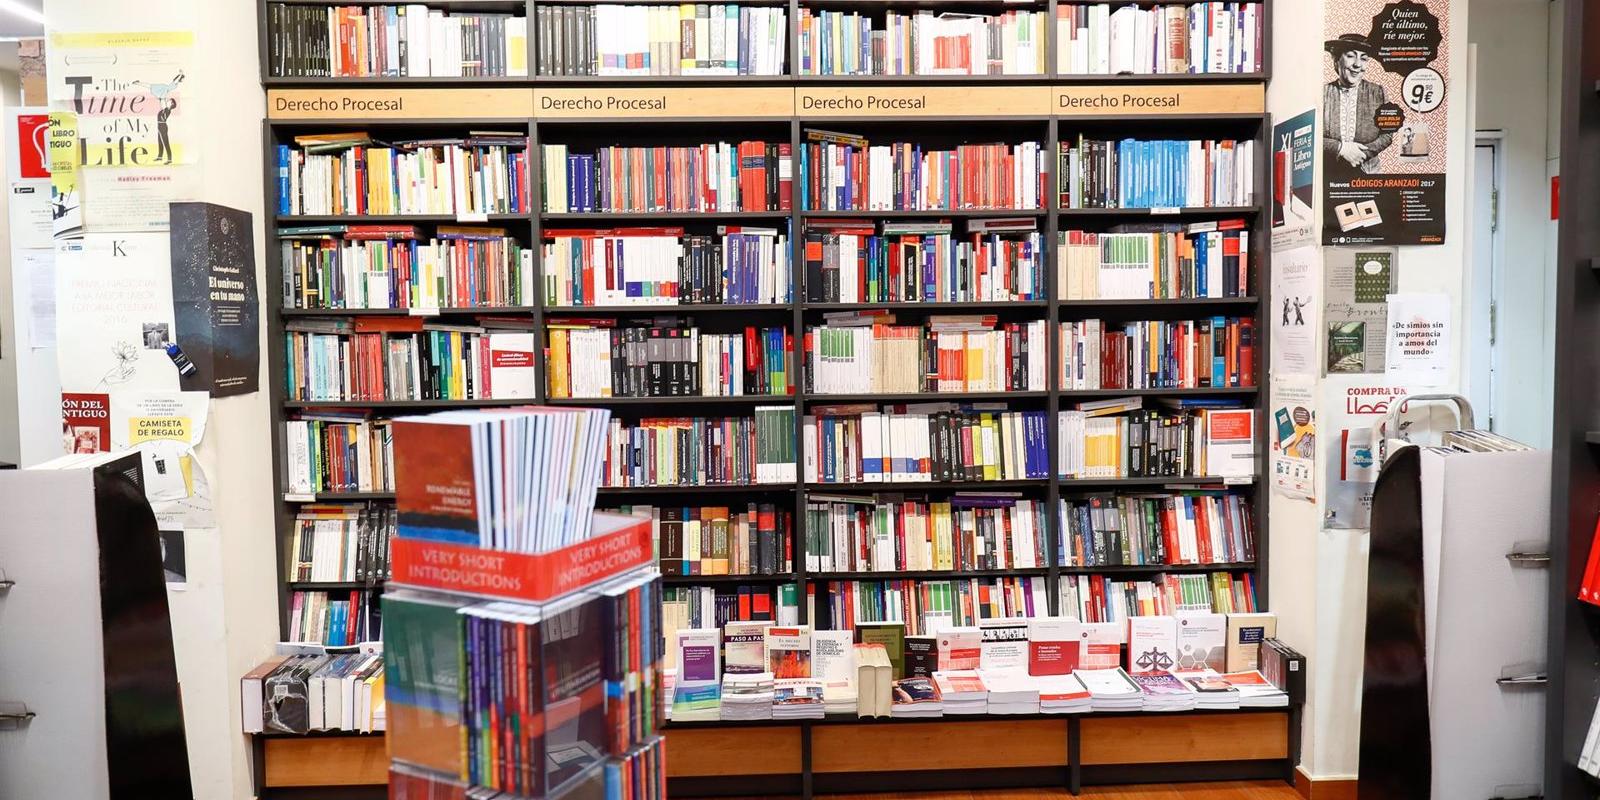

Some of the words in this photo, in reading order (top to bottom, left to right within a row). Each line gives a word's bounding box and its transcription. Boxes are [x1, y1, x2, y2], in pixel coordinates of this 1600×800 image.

[1392, 8, 1419, 18] Quien
[1382, 20, 1394, 29] ríe
[1396, 20, 1428, 30] último,
[1384, 31, 1396, 40] ríe
[1398, 31, 1426, 42] mejor.
[102, 78, 130, 90] The
[65, 76, 146, 114] Time
[1412, 84, 1424, 104] 9
[276, 98, 338, 111] Derecho
[342, 98, 402, 111] Procesal
[541, 97, 603, 110] Derecho
[607, 96, 666, 110] Procesal
[803, 96, 863, 109] Derecho
[868, 96, 926, 109] Procesal
[1060, 94, 1118, 108] Derecho
[1123, 94, 1180, 107] Procesal
[103, 118, 122, 133] of
[128, 118, 151, 138] My
[1281, 132, 1292, 151] XI
[80, 136, 148, 166] Life
[1294, 150, 1311, 162] Libro
[1351, 179, 1383, 188] CÓDIGOS
[1384, 179, 1419, 187] ARANZADI
[113, 240, 127, 256] K
[209, 276, 217, 288] El
[217, 278, 244, 289] universo
[210, 291, 219, 300] en
[220, 291, 227, 301] tu
[228, 292, 245, 302] mano
[1348, 388, 1390, 396] COMPRA
[80, 400, 103, 409] DEL
[570, 544, 598, 566] VERY
[600, 533, 632, 555] SHORT
[422, 550, 456, 565] VERY
[458, 554, 504, 569] SHORT
[558, 548, 642, 586] INTRODUCTIONS
[408, 565, 521, 591] INTRODUCTIONS
